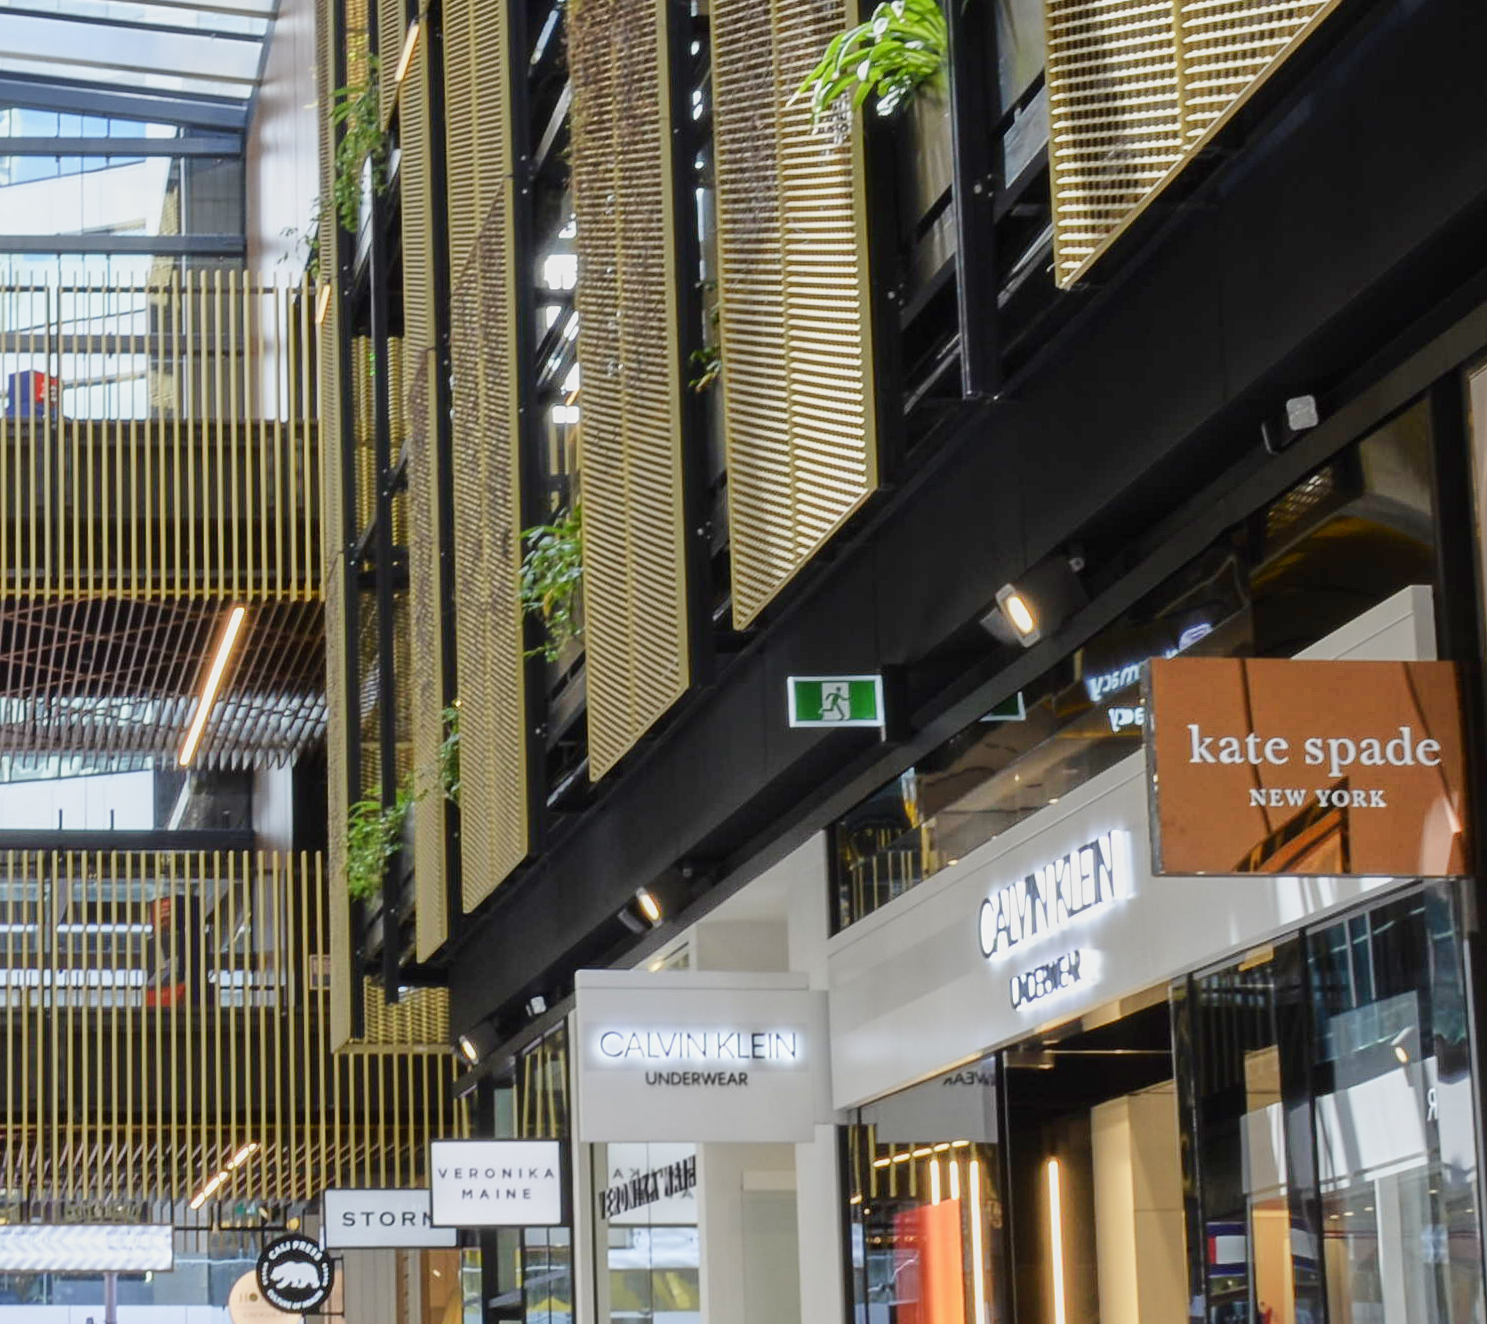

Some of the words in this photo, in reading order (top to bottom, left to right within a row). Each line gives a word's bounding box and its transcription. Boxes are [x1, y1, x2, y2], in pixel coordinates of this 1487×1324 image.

[1187, 724, 1290, 765] kate
[1304, 726, 1441, 778] spade
[1249, 788, 1306, 807] NEW
[1314, 788, 1387, 808] YORK
[599, 1031, 708, 1059] CALVIN
[716, 1032, 797, 1060] KLEIN
[644, 1071, 749, 1087] UNDERWEAR
[437, 1167, 556, 1180] VERONIKA
[461, 1188, 532, 1200] MAINE
